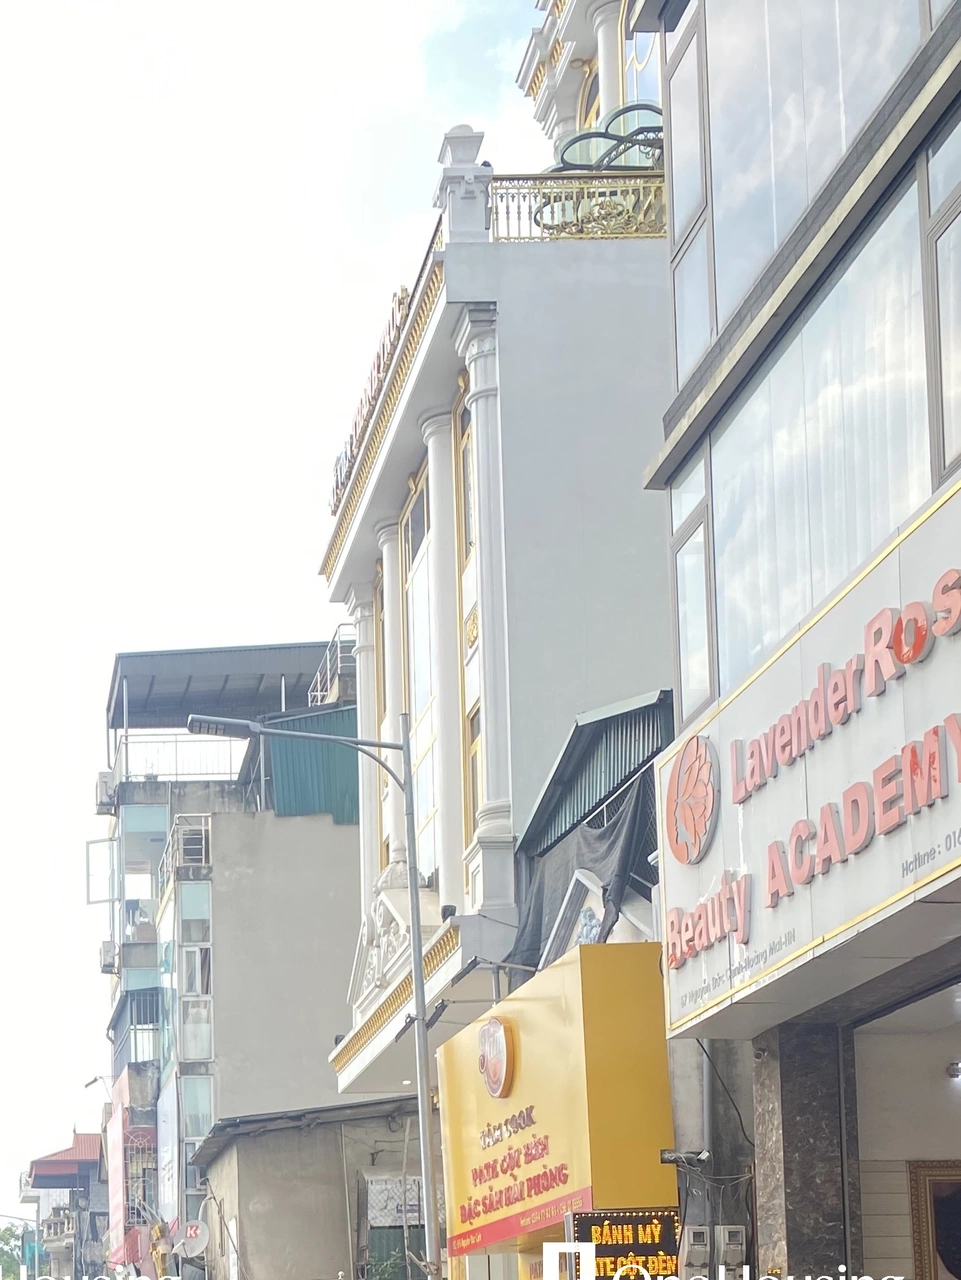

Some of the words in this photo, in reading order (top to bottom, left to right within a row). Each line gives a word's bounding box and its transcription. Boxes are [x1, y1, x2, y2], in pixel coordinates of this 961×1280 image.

[667, 869, 752, 969] Beauty
[460, 1196, 482, 1226] ĐẶC
[526, 1164, 569, 1199] PHÒNG
[186, 1225, 200, 1237] K+
[591, 1219, 634, 1245] BÁNH
[638, 1218, 662, 1244] MỲ
[617, 1251, 645, 1280] CỘT
[647, 1250, 677, 1275] ĐÈN
